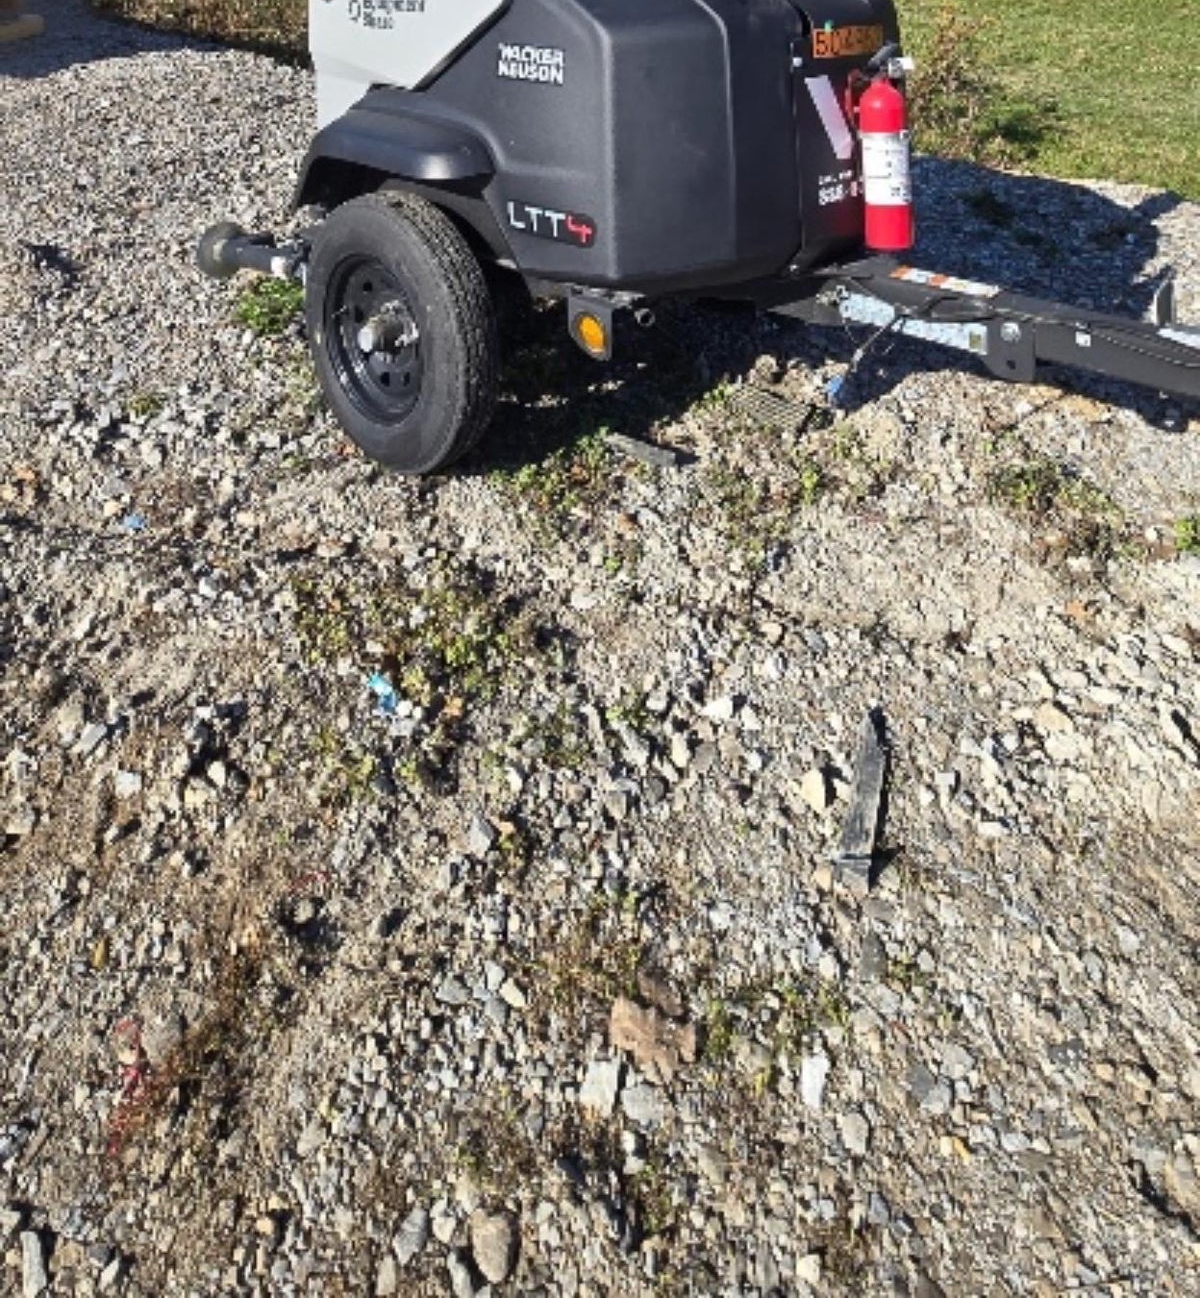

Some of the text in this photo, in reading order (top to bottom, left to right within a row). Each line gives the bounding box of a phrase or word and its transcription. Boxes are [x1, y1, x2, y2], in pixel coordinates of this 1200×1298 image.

[498, 43, 564, 67] WACKER
[498, 60, 564, 84] NEUSON
[507, 201, 593, 244] LTT4
